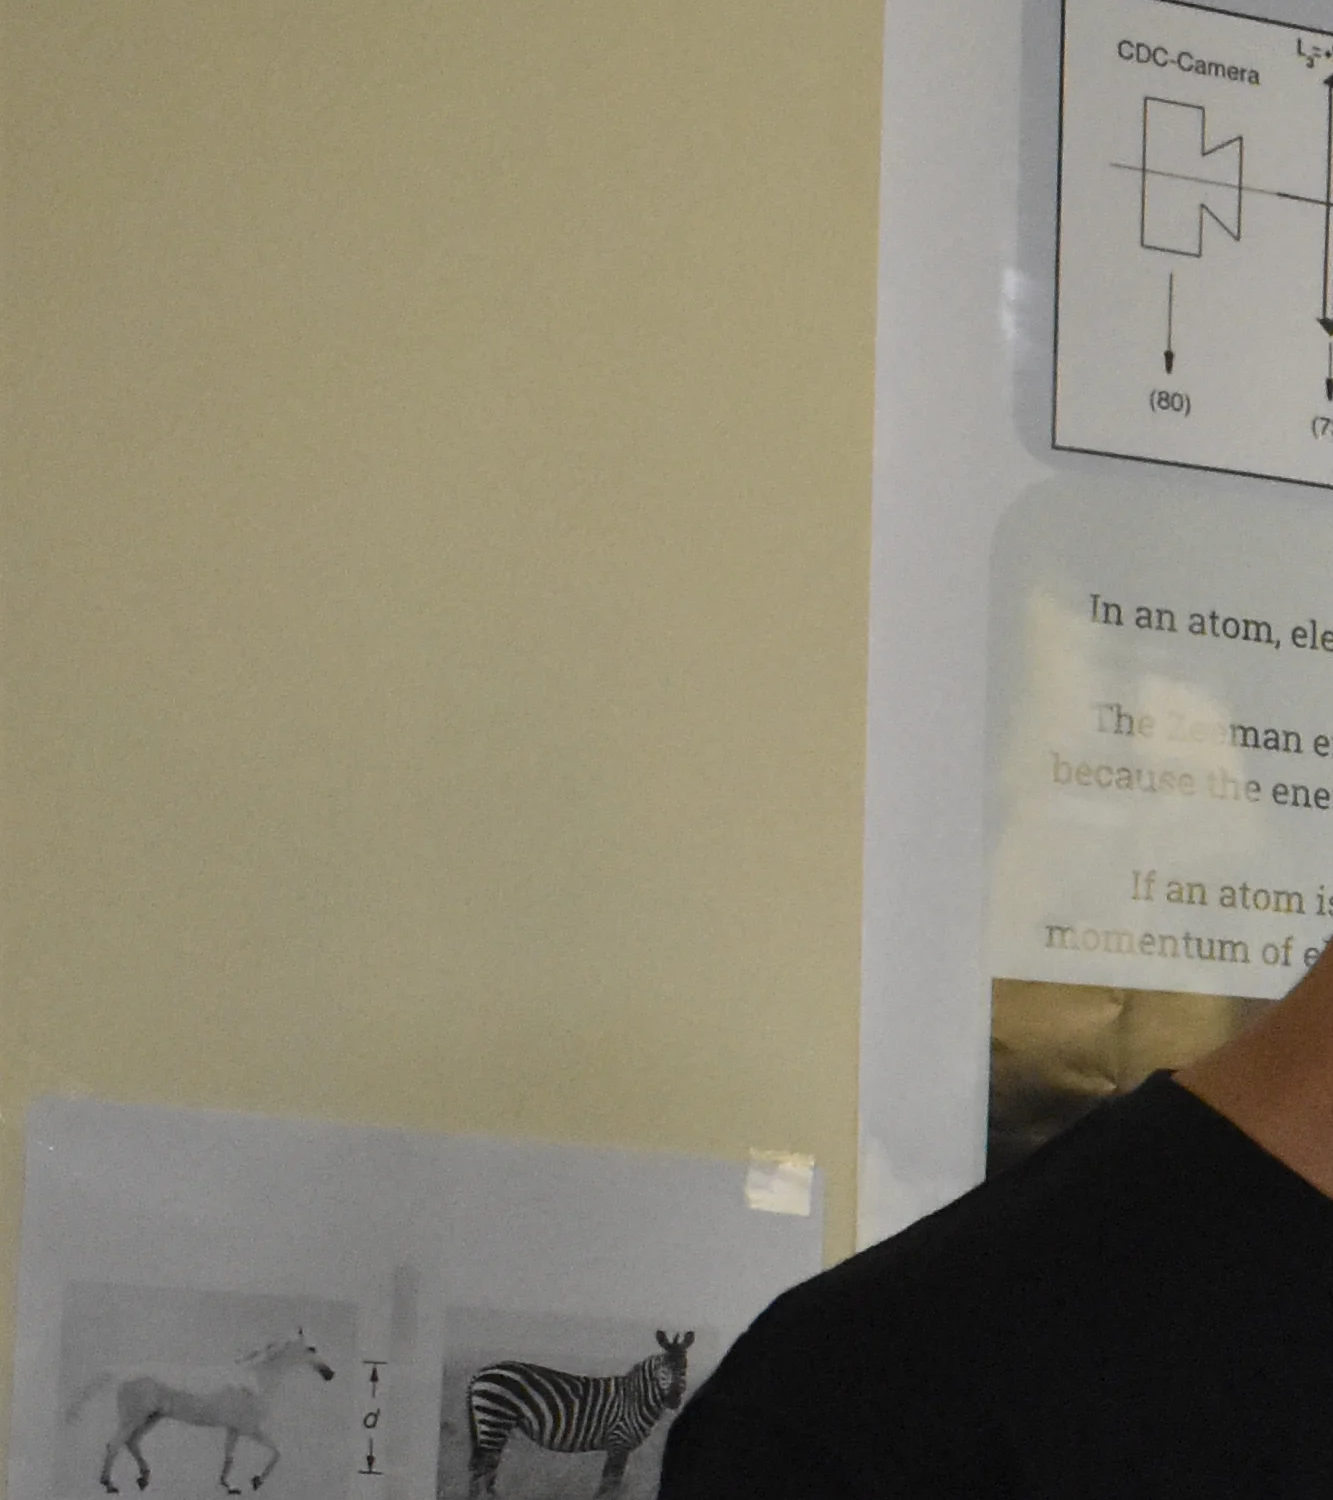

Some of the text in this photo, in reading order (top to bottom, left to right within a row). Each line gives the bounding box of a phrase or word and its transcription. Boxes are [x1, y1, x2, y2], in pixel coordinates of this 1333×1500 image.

[1117, 40, 1260, 87] CDC-Camera
[1149, 388, 1192, 417] (80)
[1088, 593, 1281, 650] In an atom,
